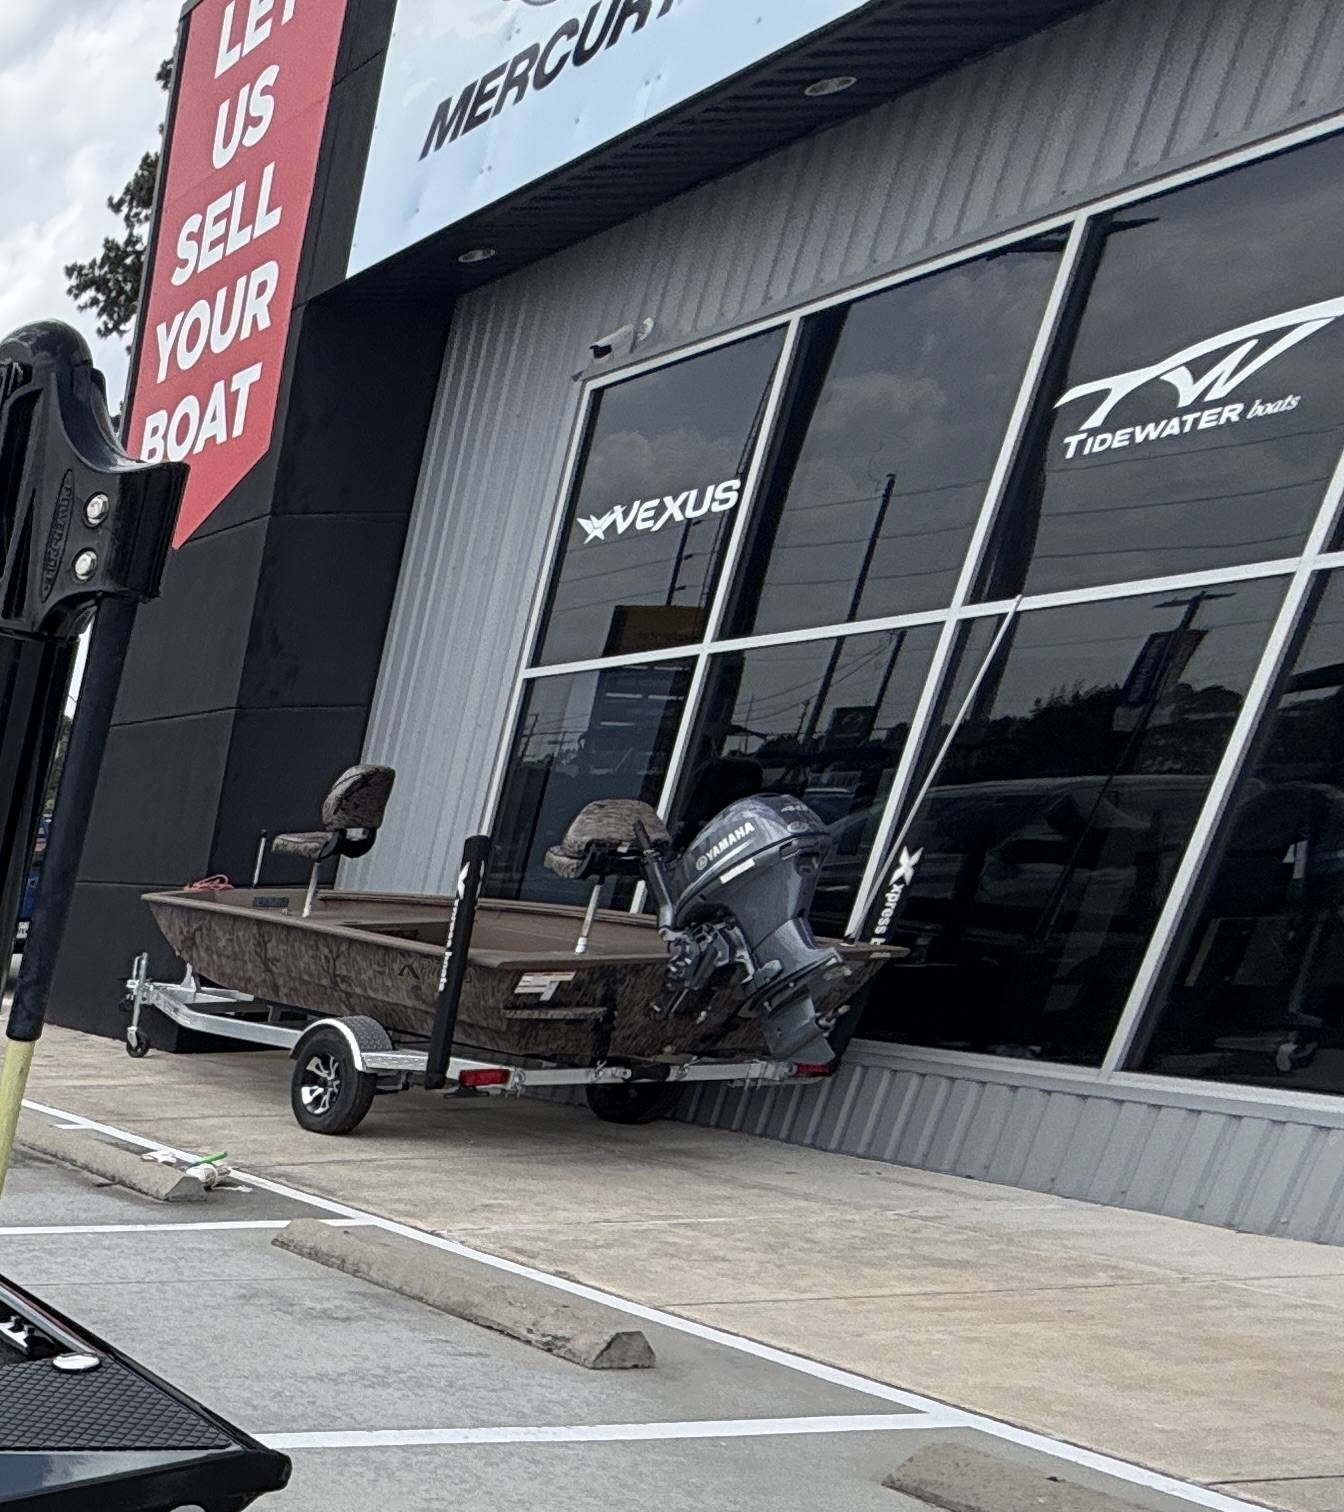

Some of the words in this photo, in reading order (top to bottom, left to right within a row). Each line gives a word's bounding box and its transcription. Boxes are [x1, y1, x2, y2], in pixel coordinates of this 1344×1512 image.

[212, 64, 276, 170] US
[418, 0, 674, 161] MERCUR
[171, 161, 282, 288] SELL
[156, 259, 280, 384] YOUR
[140, 364, 262, 465] BOAT
[1246, 394, 1303, 421] boats
[613, 478, 742, 536] VEXUS
[706, 821, 755, 862] YAMAHA
